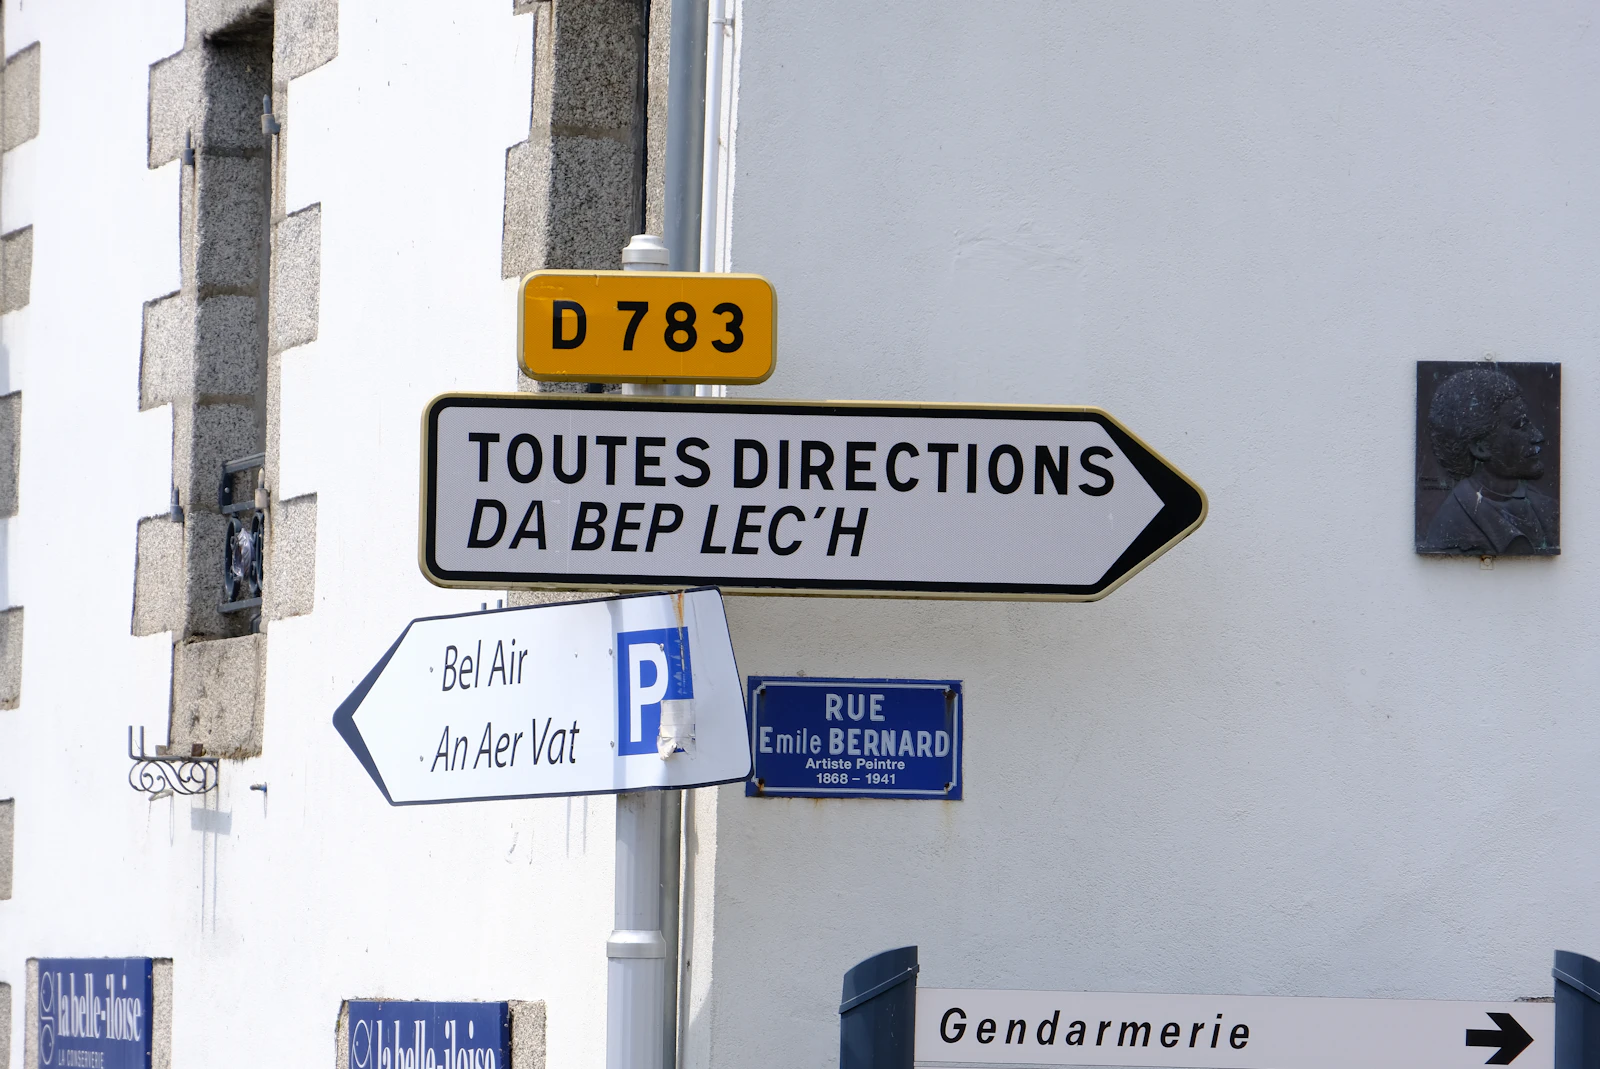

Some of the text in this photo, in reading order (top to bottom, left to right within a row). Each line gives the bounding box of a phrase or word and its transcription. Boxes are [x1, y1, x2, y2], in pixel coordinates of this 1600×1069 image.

[552, 300, 744, 353] D 783
[468, 432, 1115, 497] TOUTES DIRECTIONS
[467, 498, 869, 557] DA BEP LEC'H
[442, 638, 528, 692] Bel Air
[628, 642, 669, 743] P
[825, 693, 886, 722] RUE
[430, 717, 580, 773] An Aer Vat
[759, 726, 950, 758] Emile BERNARD
[805, 757, 906, 770] Artiste Peintre
[816, 772, 849, 784] 1868
[865, 773, 896, 785] 1941
[939, 1007, 1250, 1050] Gendarmerie
